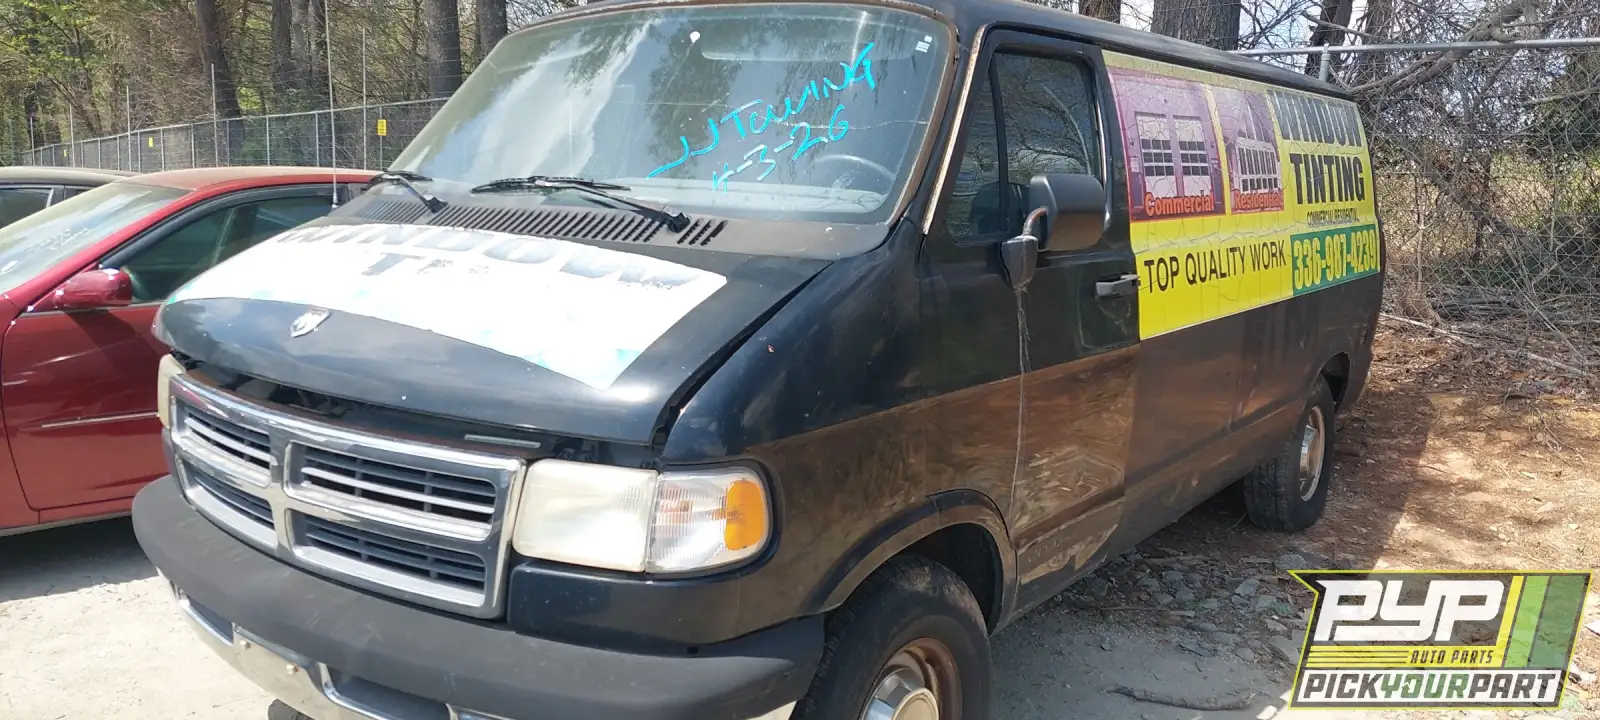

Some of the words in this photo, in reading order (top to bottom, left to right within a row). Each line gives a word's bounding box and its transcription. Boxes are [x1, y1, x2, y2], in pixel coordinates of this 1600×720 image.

[712, 104, 849, 194] 4-3-26
[1144, 191, 1215, 216] Commercial
[1234, 190, 1283, 209] Residential
[1290, 153, 1365, 205] TINTING
[1144, 256, 1180, 293] TOP
[1185, 246, 1246, 285] QUALITY
[1249, 240, 1287, 272] WORK
[1293, 229, 1377, 290] 336-987-4239
